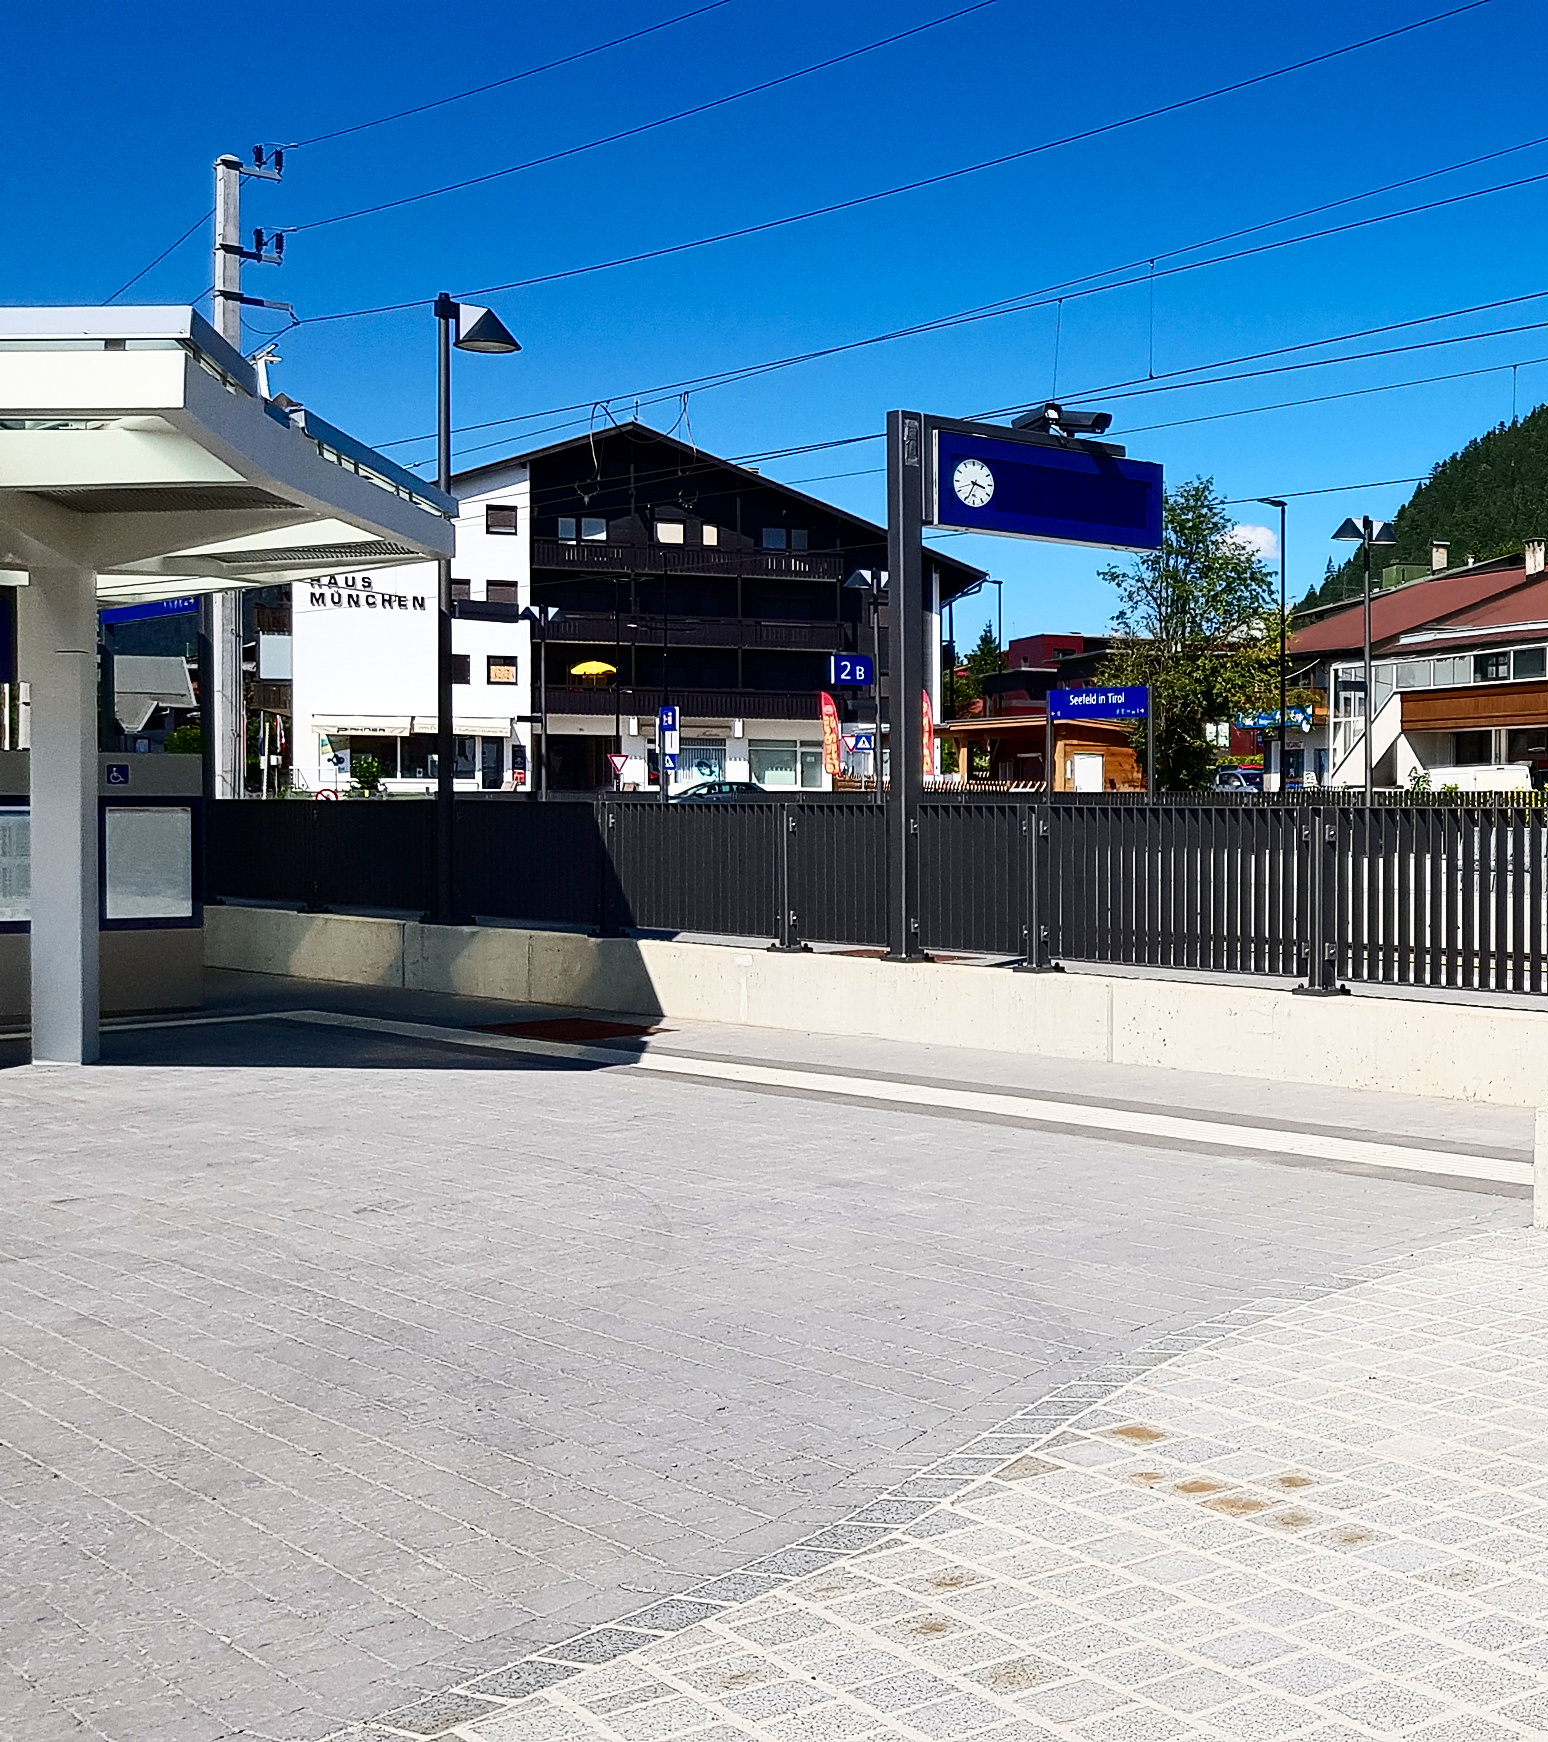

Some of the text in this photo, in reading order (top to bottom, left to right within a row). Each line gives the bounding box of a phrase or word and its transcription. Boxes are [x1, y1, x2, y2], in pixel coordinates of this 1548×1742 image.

[310, 590, 426, 611] MÜNCHEN
[1069, 692, 1125, 705] Seefeld in Tirol
